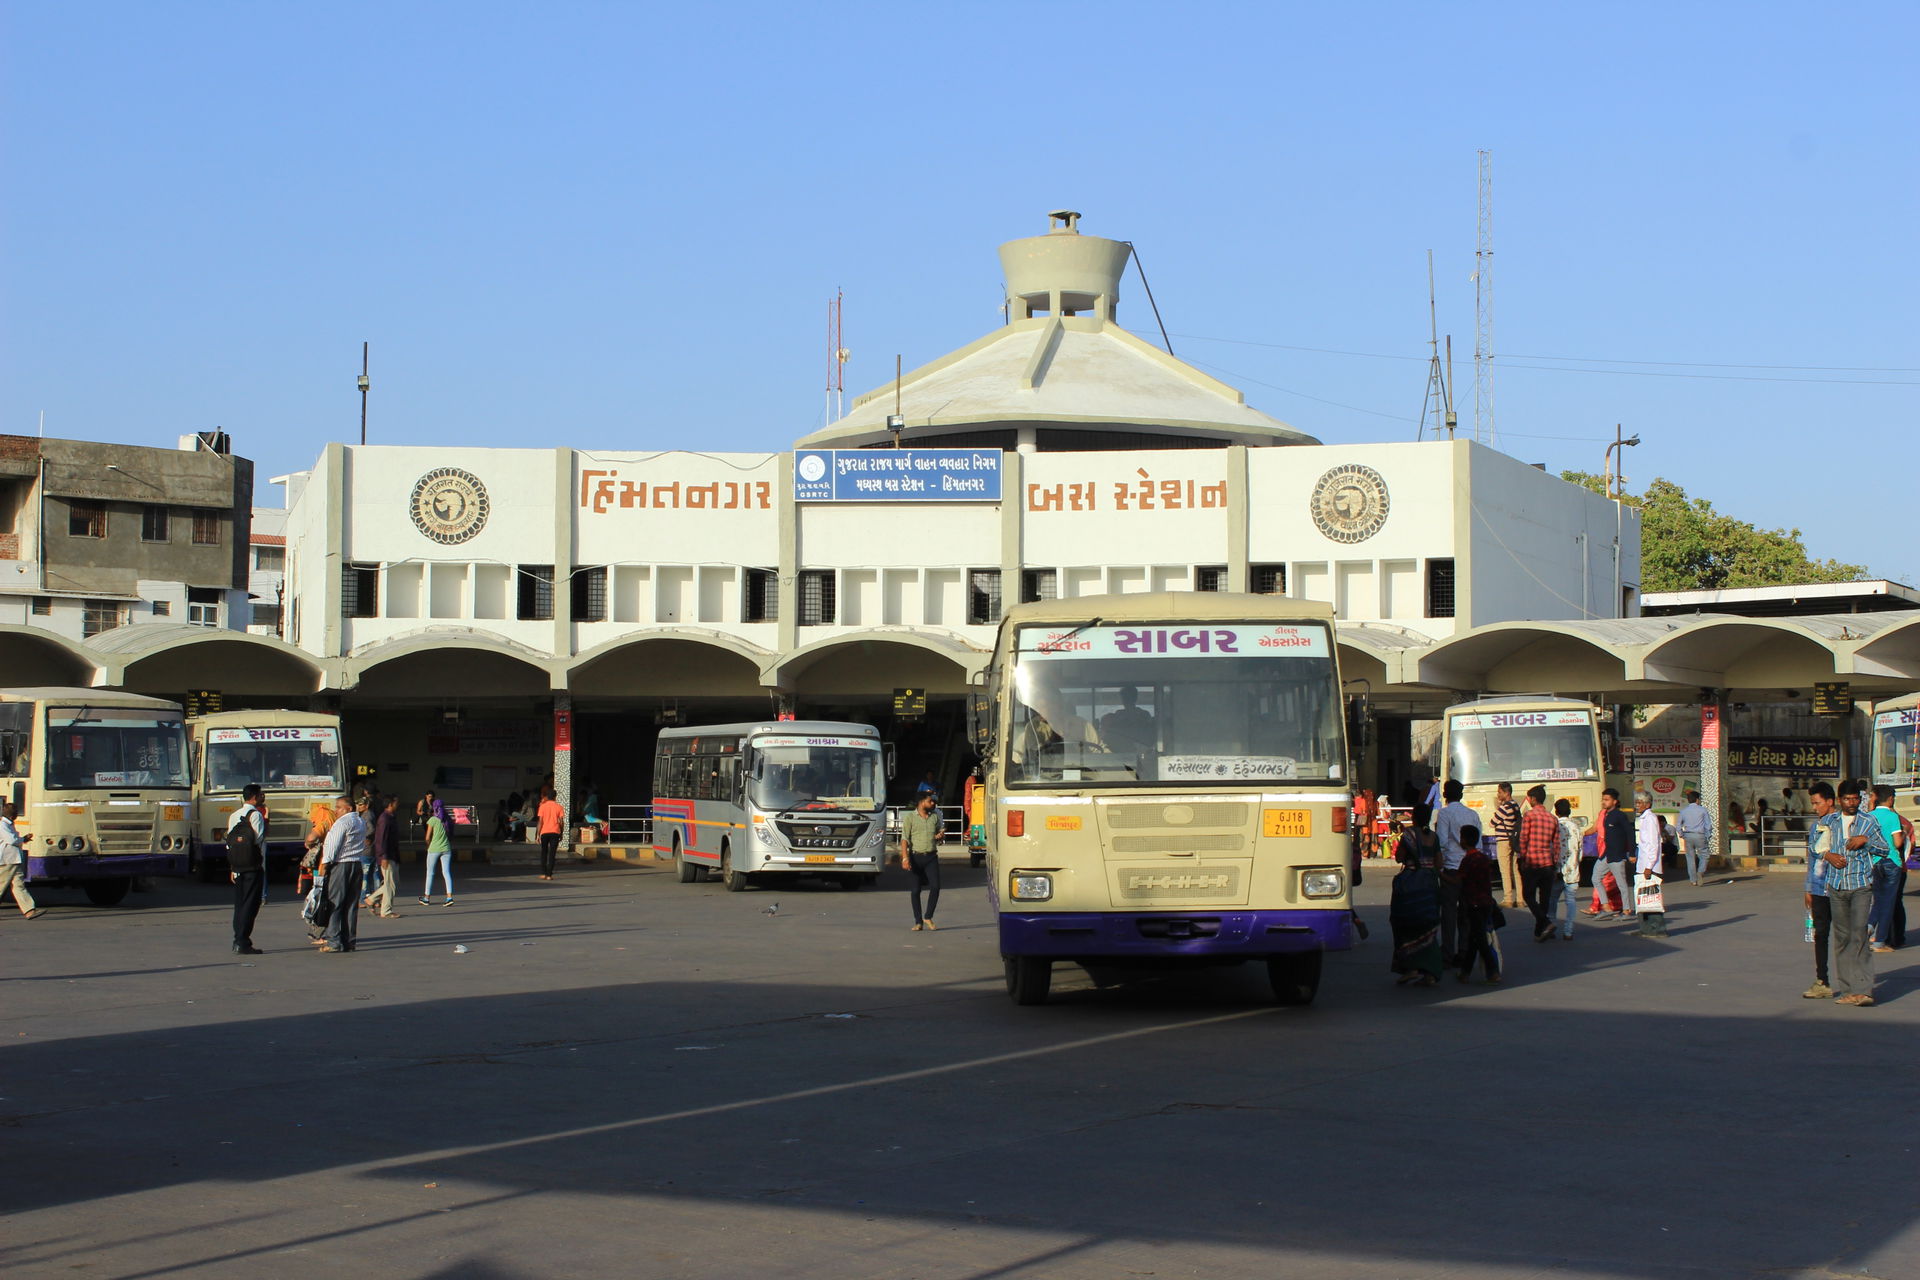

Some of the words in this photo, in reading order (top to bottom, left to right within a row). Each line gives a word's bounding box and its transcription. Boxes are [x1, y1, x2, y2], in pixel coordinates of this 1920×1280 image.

[837, 457, 868, 476] ગુજરાત
[894, 452, 913, 471] માર્ગ
[914, 457, 937, 471] વાહન
[972, 453, 997, 471] નિગમ
[884, 478, 899, 492] બસ
[901, 474, 925, 492] સ્ટેશન
[1028, 482, 1096, 512] બસ
[1114, 467, 1228, 511] સ્ટેશન
[581, 469, 771, 514] હિંમતનગર
[1114, 630, 1239, 654] સાબર
[1491, 714, 1548, 726] સાબર
[249, 729, 302, 740] સાબર
[807, 738, 840, 746] આશ્રમ
[1748, 745, 1787, 766] કેરિયર
[1793, 747, 1838, 768] એકેડમી
[1642, 761, 1651, 769] @
[1654, 761, 1664, 769] 75
[1665, 760, 1676, 769] 75
[1676, 760, 1687, 769] 07
[1279, 811, 1304, 823] GJ18
[1275, 824, 1305, 836] Z1110
[798, 838, 850, 847] EICHER
[1129, 874, 1229, 890] EICHER
